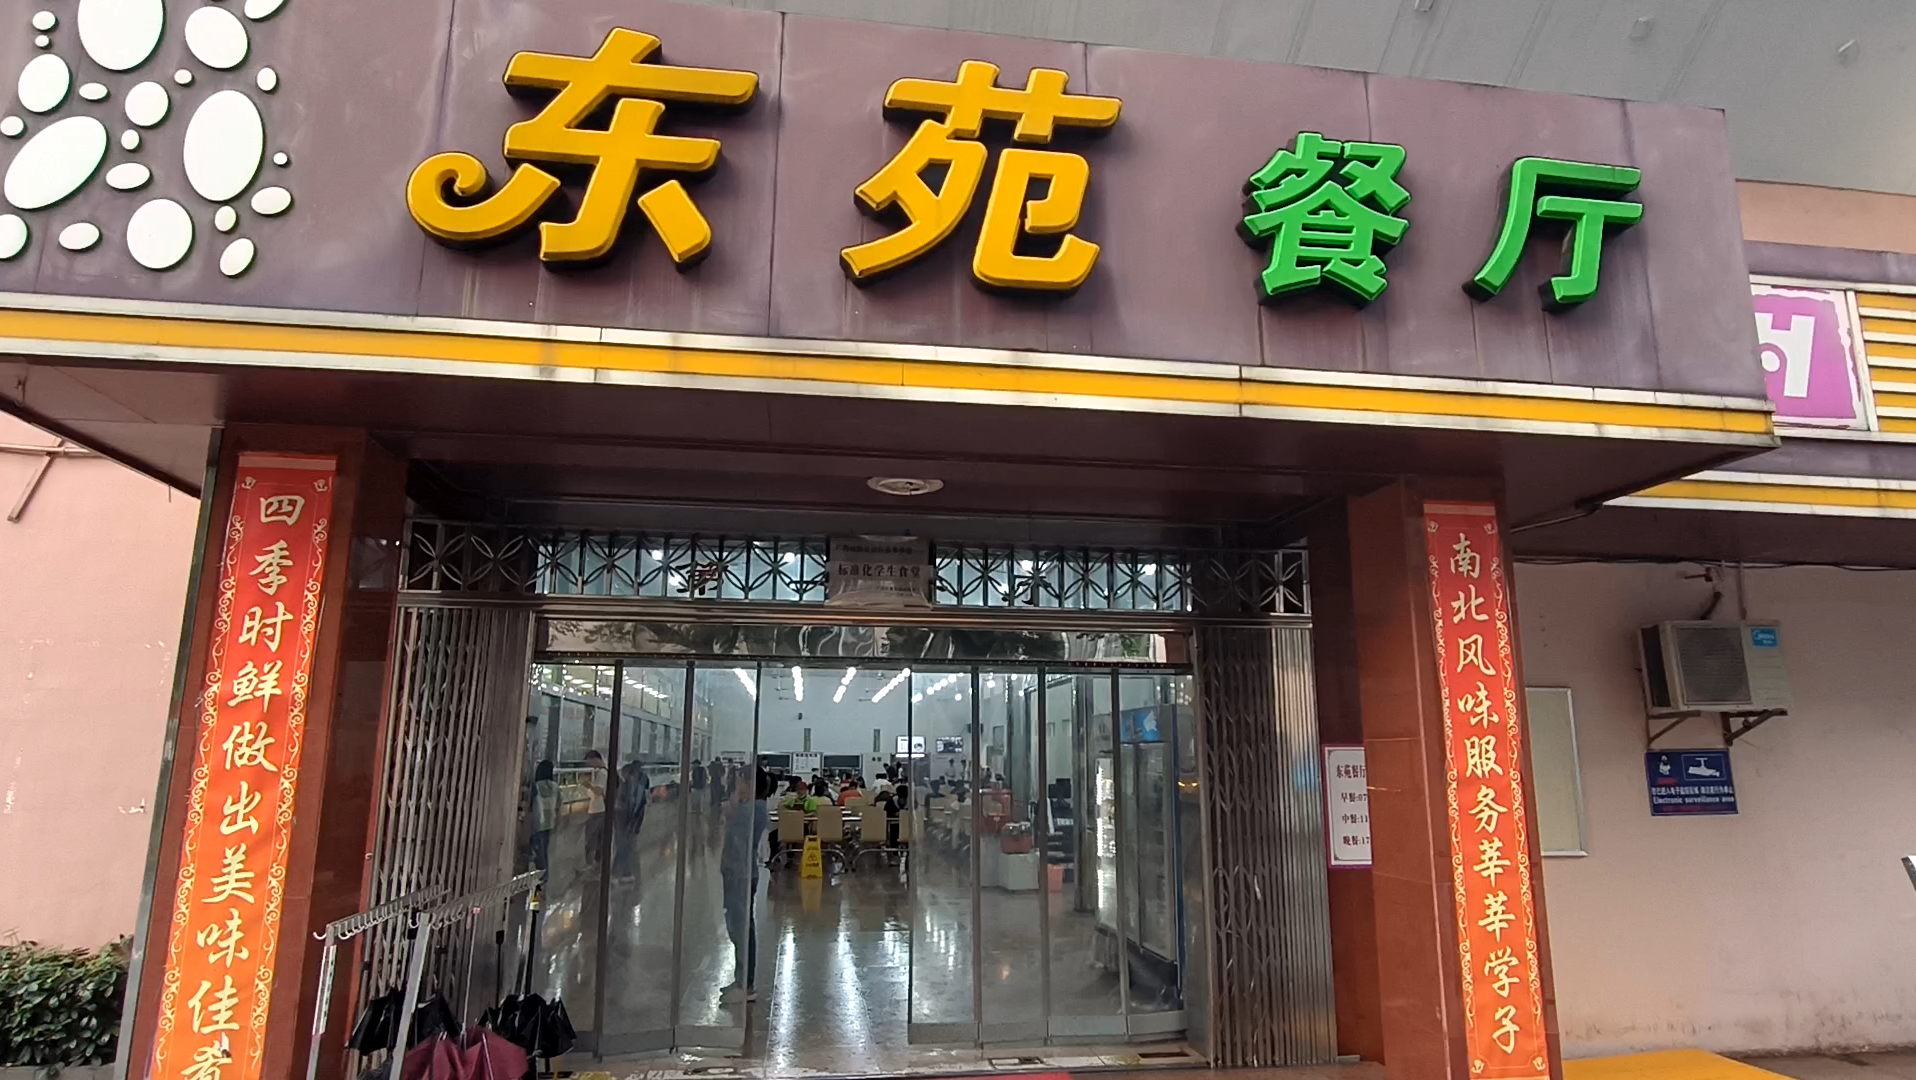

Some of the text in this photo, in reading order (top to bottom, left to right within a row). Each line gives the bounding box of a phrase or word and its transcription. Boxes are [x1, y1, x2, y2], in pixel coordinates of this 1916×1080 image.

[838, 563, 921, 577] 标准化学生食堂
[1448, 531, 1522, 1056] 南北风味服务莘莘学子
